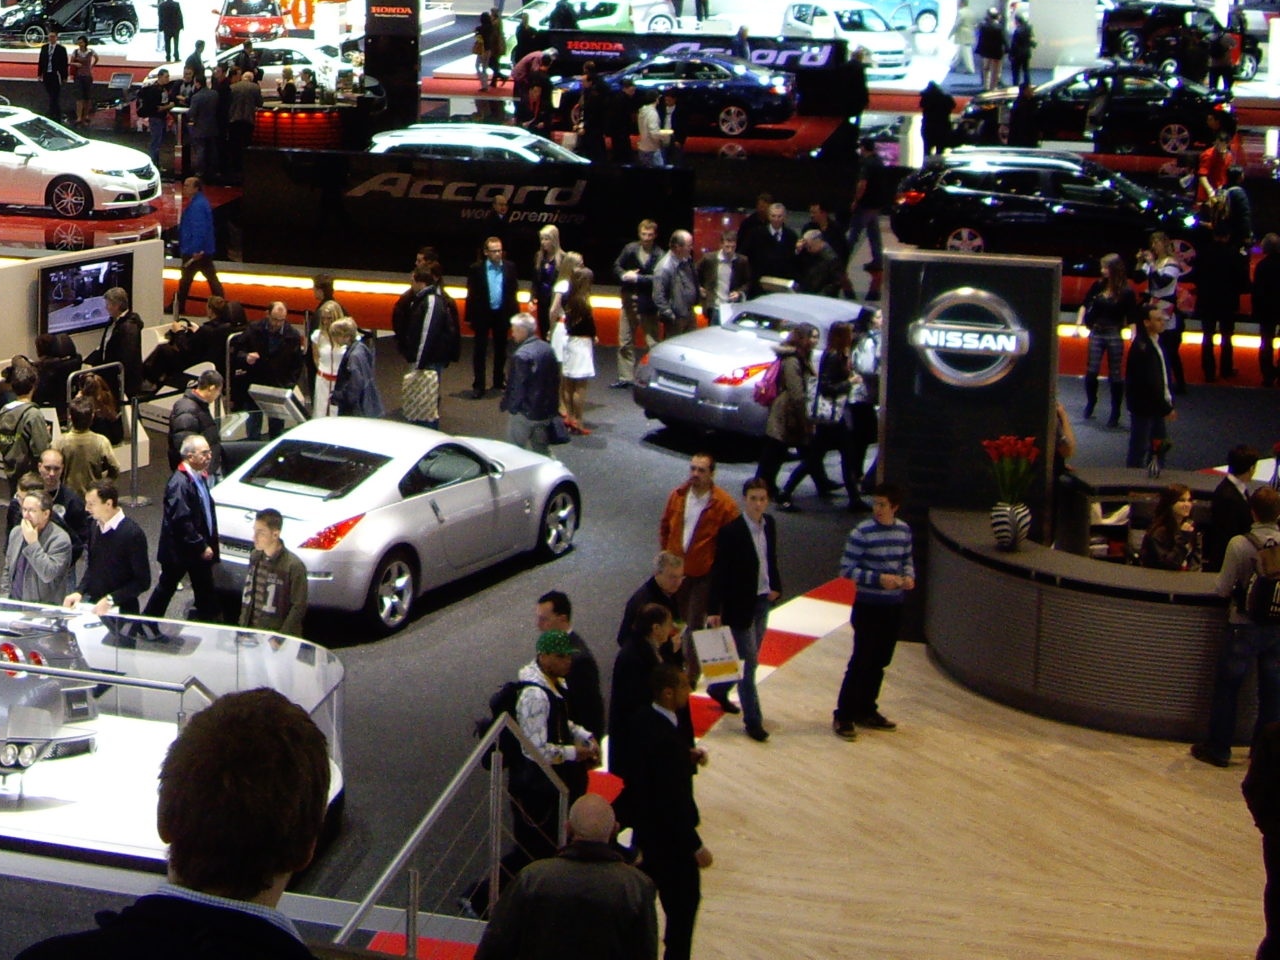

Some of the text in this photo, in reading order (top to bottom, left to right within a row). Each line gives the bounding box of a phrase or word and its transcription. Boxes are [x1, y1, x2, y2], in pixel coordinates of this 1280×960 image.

[371, 6, 403, 14] HONDA
[567, 41, 625, 51] HONDA
[345, 171, 588, 207] Accord
[508, 209, 586, 225] premiere
[919, 328, 1018, 352] NISSAN
